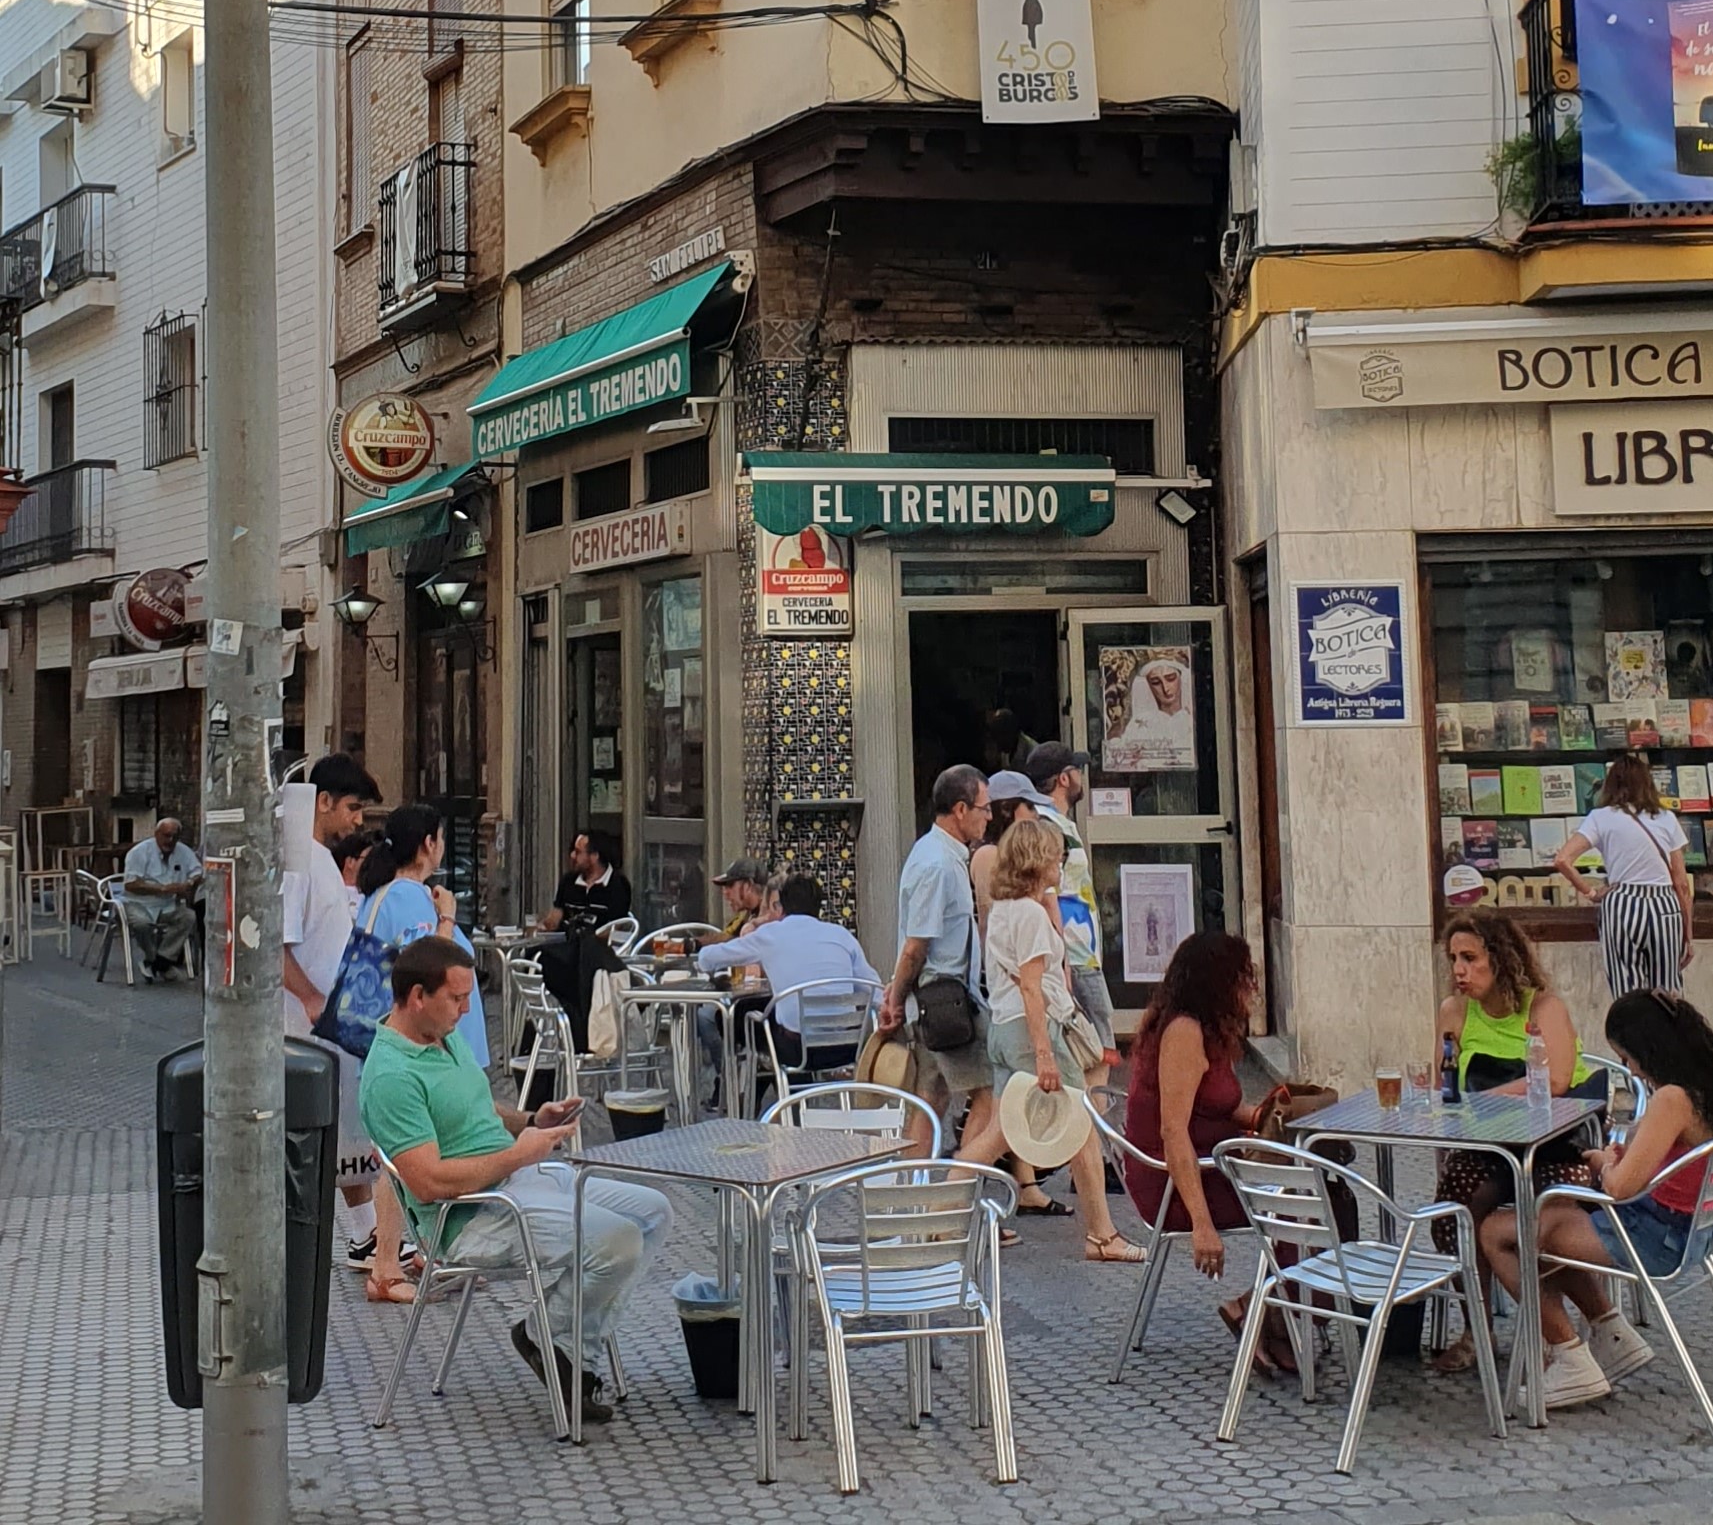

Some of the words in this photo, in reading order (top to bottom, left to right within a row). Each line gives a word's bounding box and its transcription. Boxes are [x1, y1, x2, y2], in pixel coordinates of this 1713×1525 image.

[996, 40, 1075, 71] 450
[1686, 40, 1700, 57] de
[651, 252, 671, 282] SAN
[679, 229, 721, 270] FELIPE
[1498, 341, 1701, 391] BOTICA
[477, 389, 565, 455] CERVECERÍA
[567, 388, 587, 424] EL
[590, 353, 681, 417] TREMENDO
[354, 430, 426, 447] Cruzcampo
[1582, 429, 1713, 486] LIBR
[812, 485, 853, 523] EL
[877, 484, 1058, 523] TREMENDO
[571, 511, 669, 567] CERVECERIA
[771, 573, 844, 587] Cruzcampo
[767, 609, 781, 625] EL
[786, 609, 849, 625] TREMENDO
[1315, 623, 1387, 654] BOTICA
[1322, 664, 1382, 676] LECTORES
